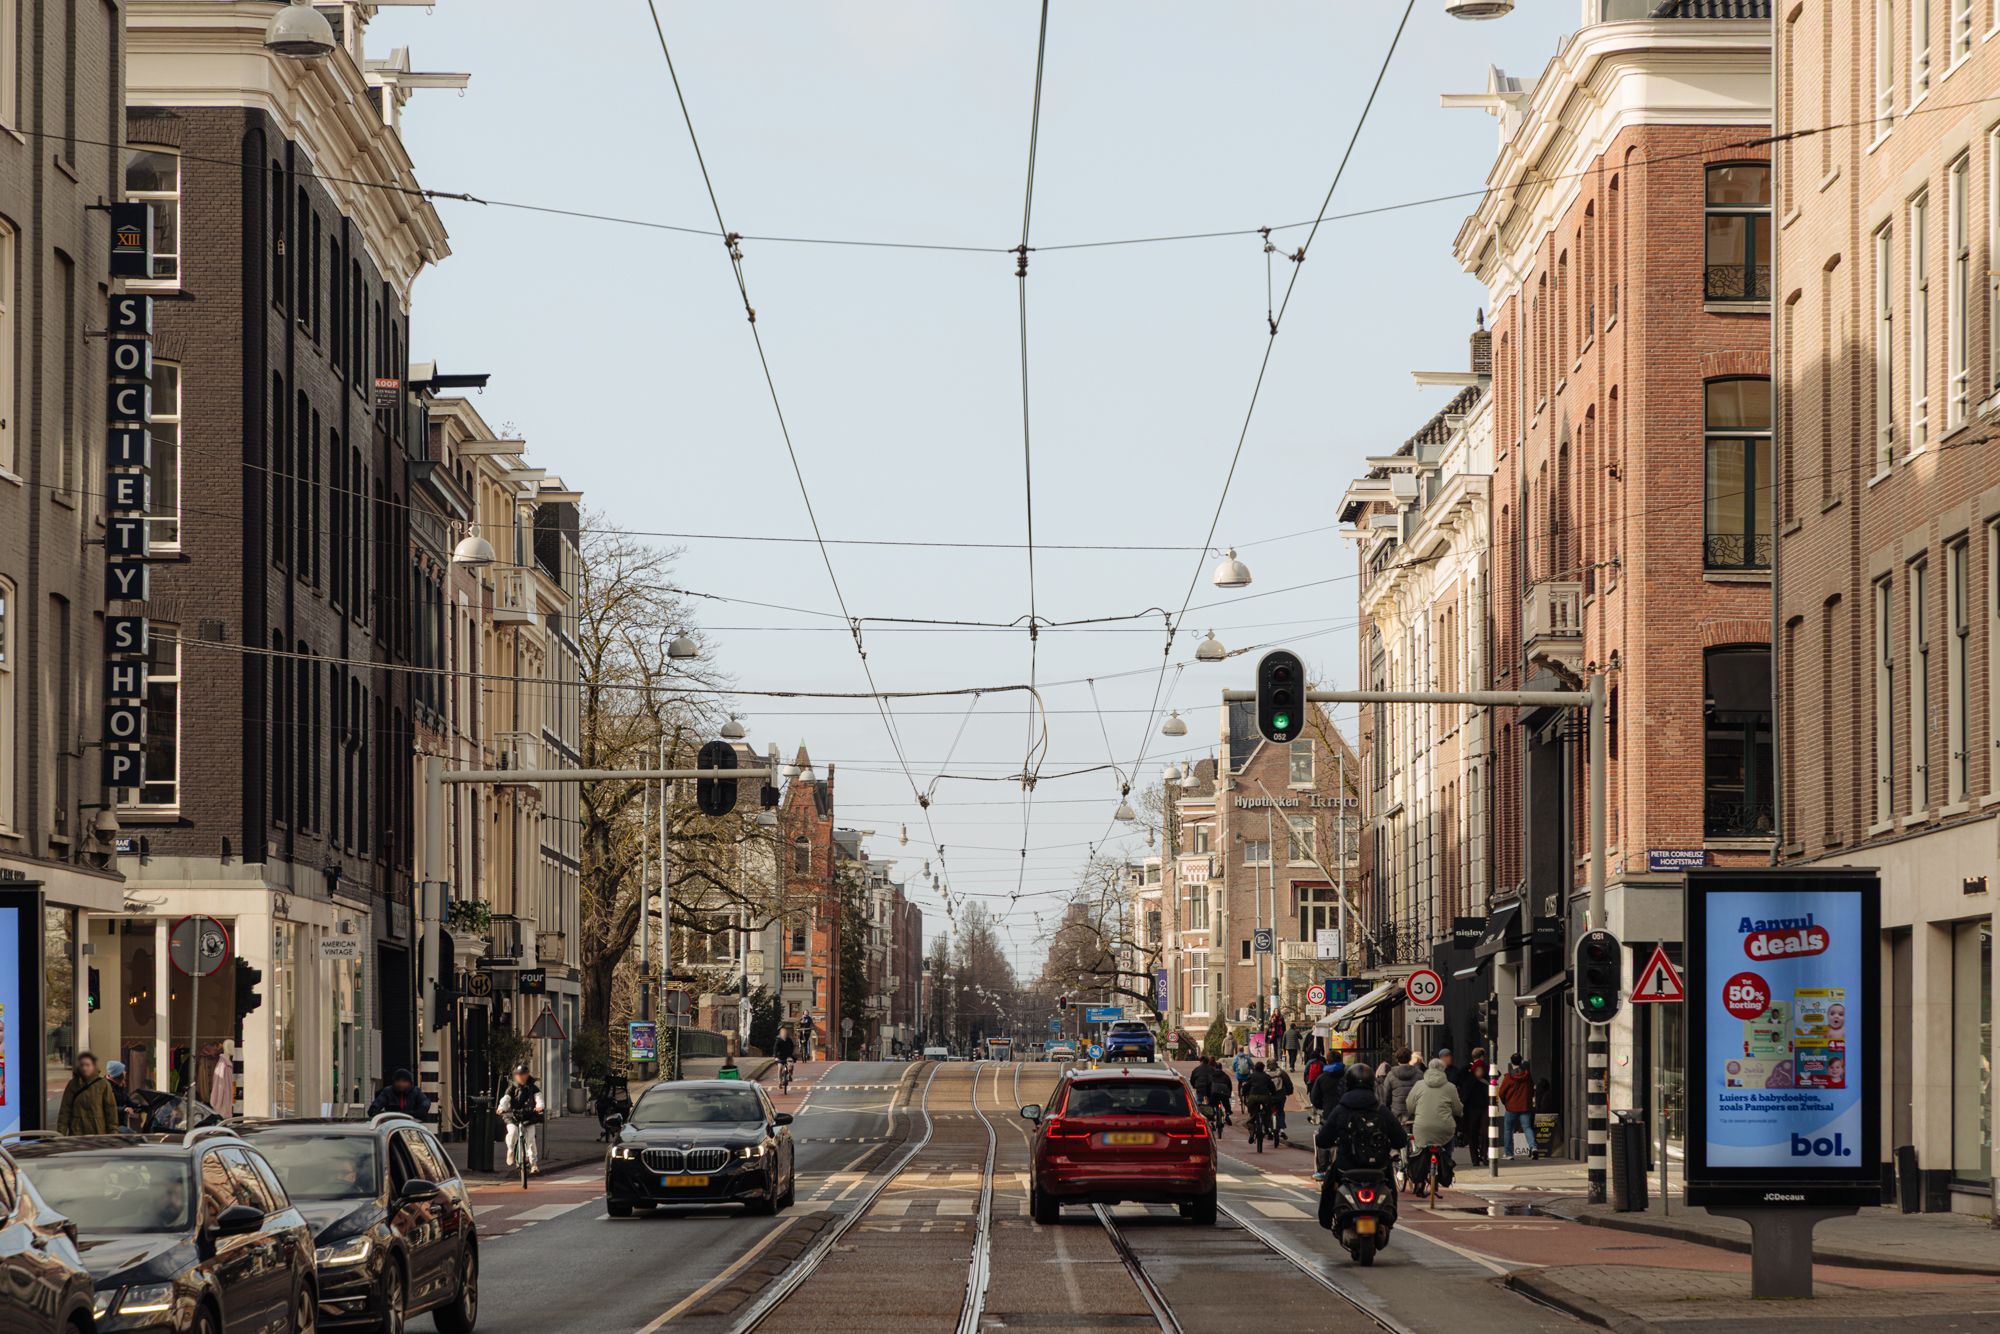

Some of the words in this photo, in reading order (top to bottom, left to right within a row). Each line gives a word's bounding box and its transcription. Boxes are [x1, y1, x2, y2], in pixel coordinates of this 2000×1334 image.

[118, 233, 140, 246] XIII
[375, 380, 398, 388] KOOP
[113, 299, 140, 594] SOCIETY
[110, 621, 136, 780] SHOP
[1273, 733, 1287, 741] 052
[1738, 913, 1814, 933] Aanvul
[1455, 929, 1484, 938] sisley
[1591, 932, 1604, 941] 051
[1750, 930, 1825, 956] deals
[1413, 982, 1436, 995] 30
[1729, 985, 1765, 1001] 50%
[1310, 992, 1323, 1000] 30
[1719, 1094, 1749, 1102] Luiers
[1750, 1094, 1757, 1102] &
[1758, 1094, 1821, 1104] babydoekjes,
[1719, 1103, 1744, 1112] zoals
[1744, 1104, 1786, 1113] Pampers
[1800, 1103, 1834, 1112] Zwitsal
[1791, 1132, 1852, 1157] bol.
[1763, 1192, 1806, 1201] JCDecaux
